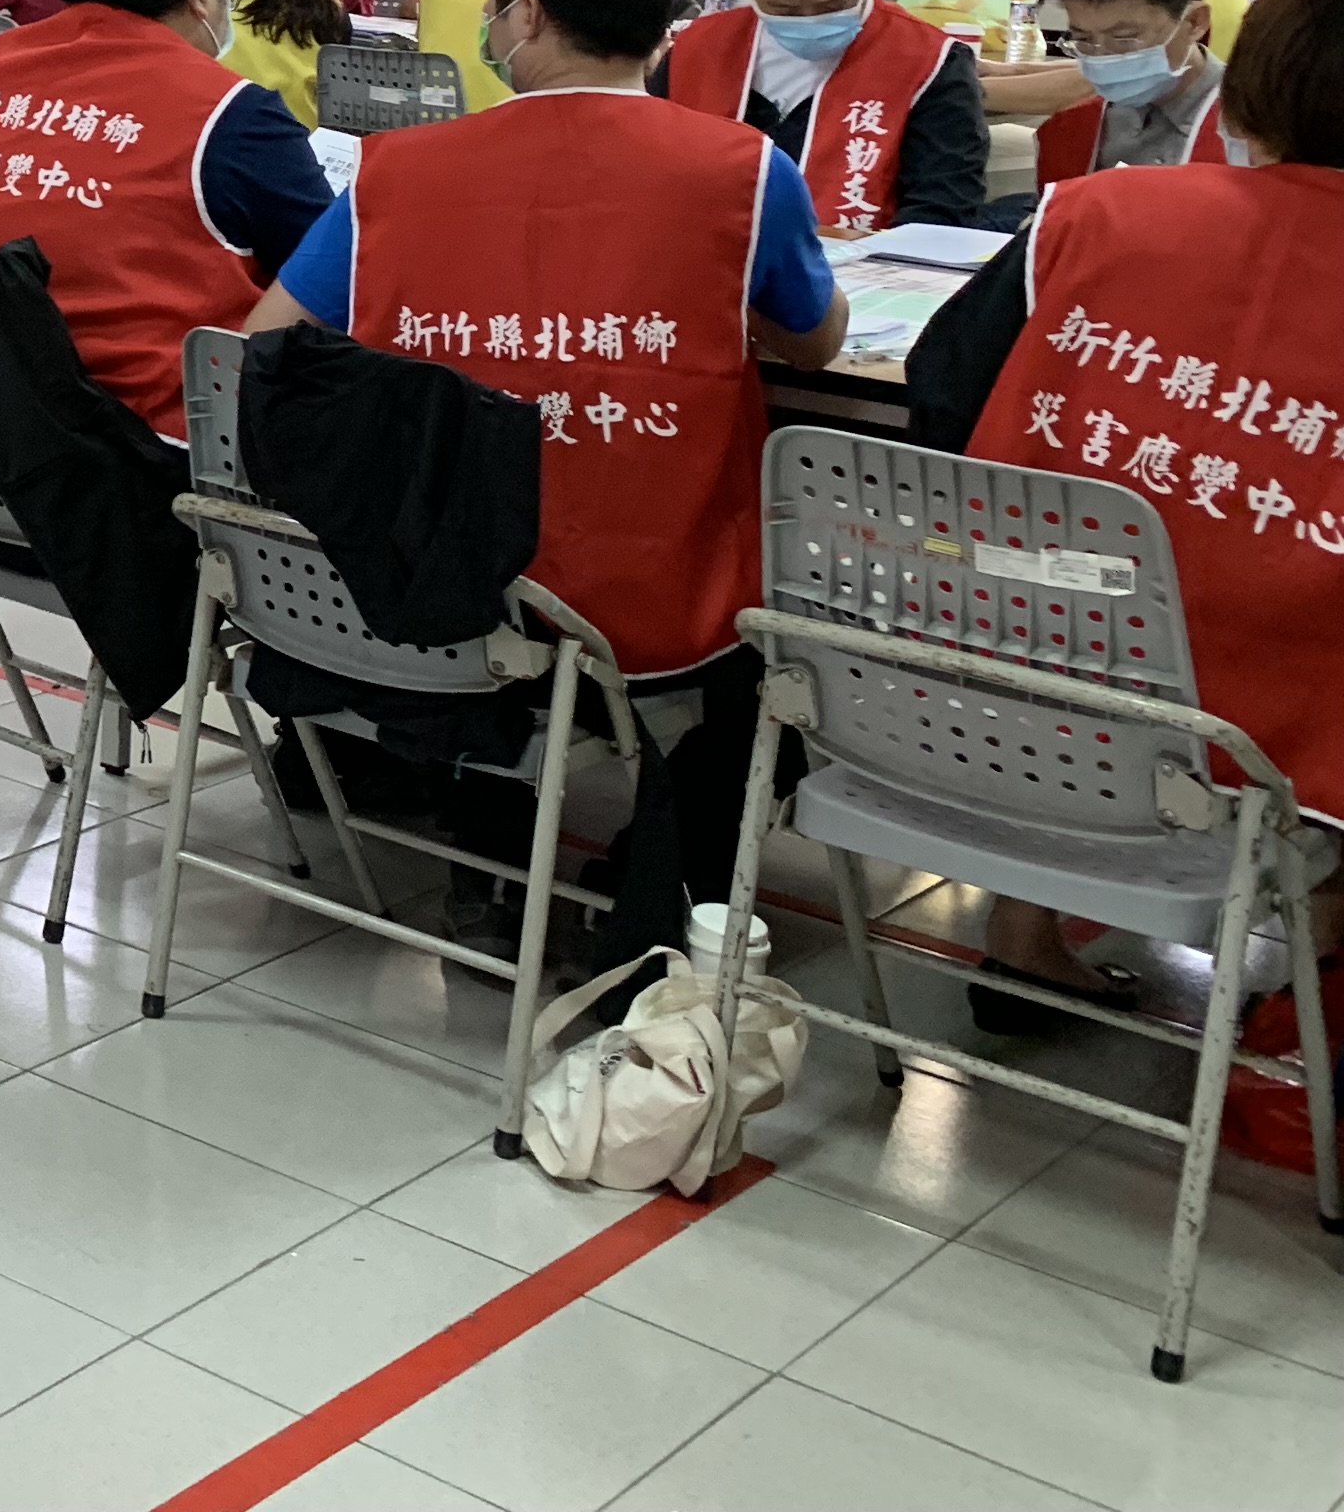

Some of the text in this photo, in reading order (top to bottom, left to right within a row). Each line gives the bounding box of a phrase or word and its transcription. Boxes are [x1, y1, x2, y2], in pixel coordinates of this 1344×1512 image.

[392, 305, 677, 364] 新竹縣北埔鄉
[1024, 389, 1344, 555] 災害應變中心
